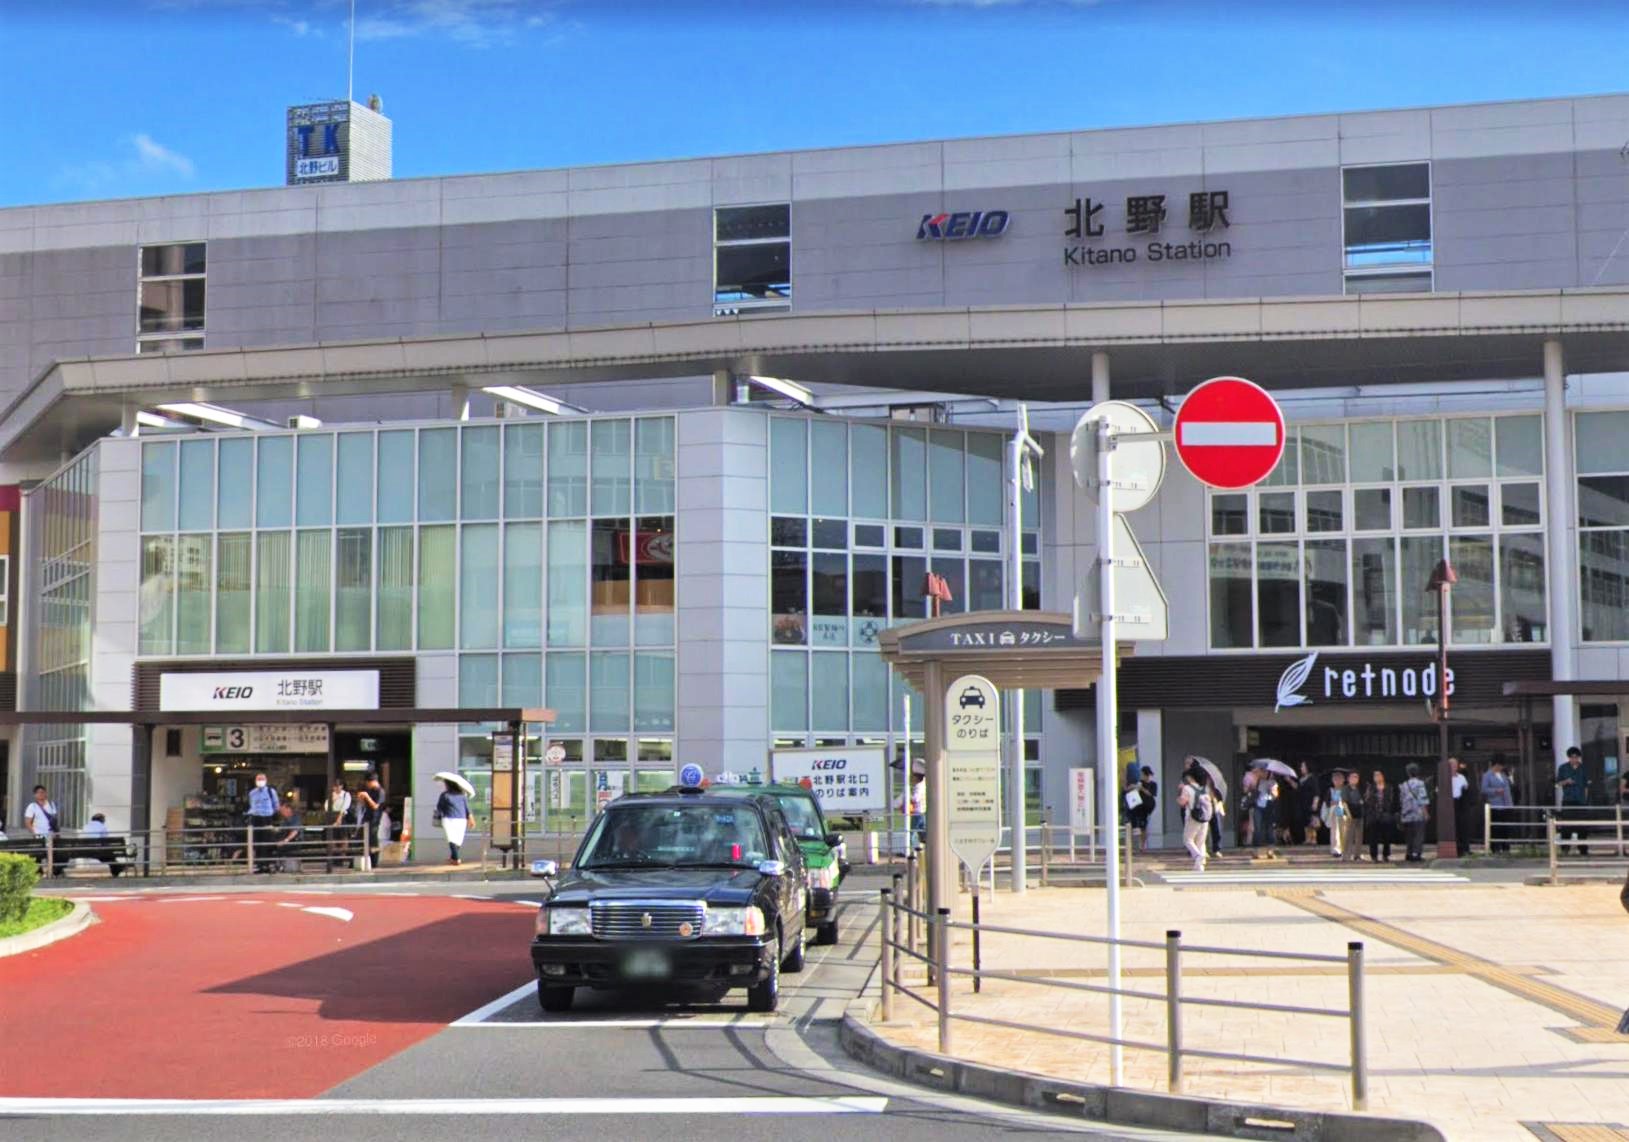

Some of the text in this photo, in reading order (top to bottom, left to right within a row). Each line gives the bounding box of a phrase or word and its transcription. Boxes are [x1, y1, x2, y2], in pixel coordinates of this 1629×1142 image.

[299, 160, 337, 175] 北野ビル
[1064, 190, 1230, 238] 北野駅
[916, 210, 1009, 240] KEIO
[1064, 241, 1231, 266] Kitano Station
[950, 632, 995, 645] TAXI
[1020, 631, 1065, 644] タクシー
[212, 687, 252, 699] KEIO
[277, 679, 323, 696] 北野駅
[952, 714, 994, 725] タクシー
[230, 728, 245, 748] 3
[956, 728, 989, 739] のりば
[812, 759, 847, 770] KEIO
[801, 774, 869, 785] 北野駅北口
